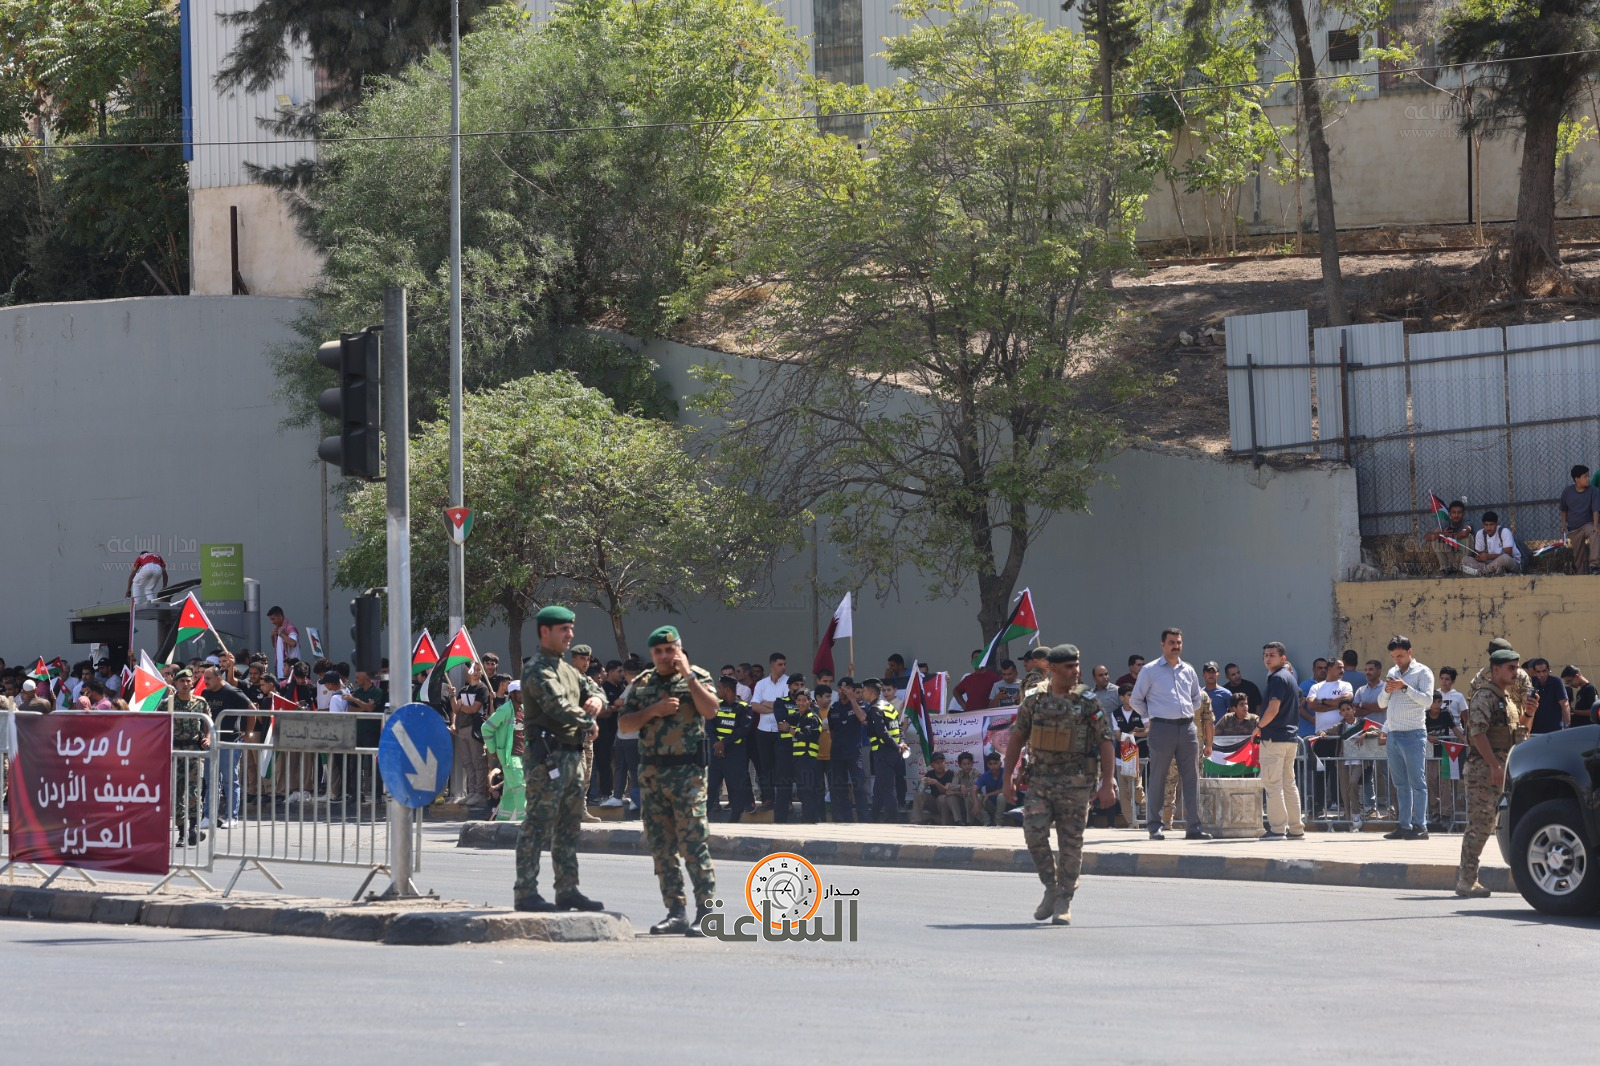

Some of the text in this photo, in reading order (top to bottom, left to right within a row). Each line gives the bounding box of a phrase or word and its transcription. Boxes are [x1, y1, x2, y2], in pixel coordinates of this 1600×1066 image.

[56, 729, 132, 766] يا مرحبا
[38, 770, 161, 812] بضيف الأردن
[61, 818, 132, 854] العزيز
